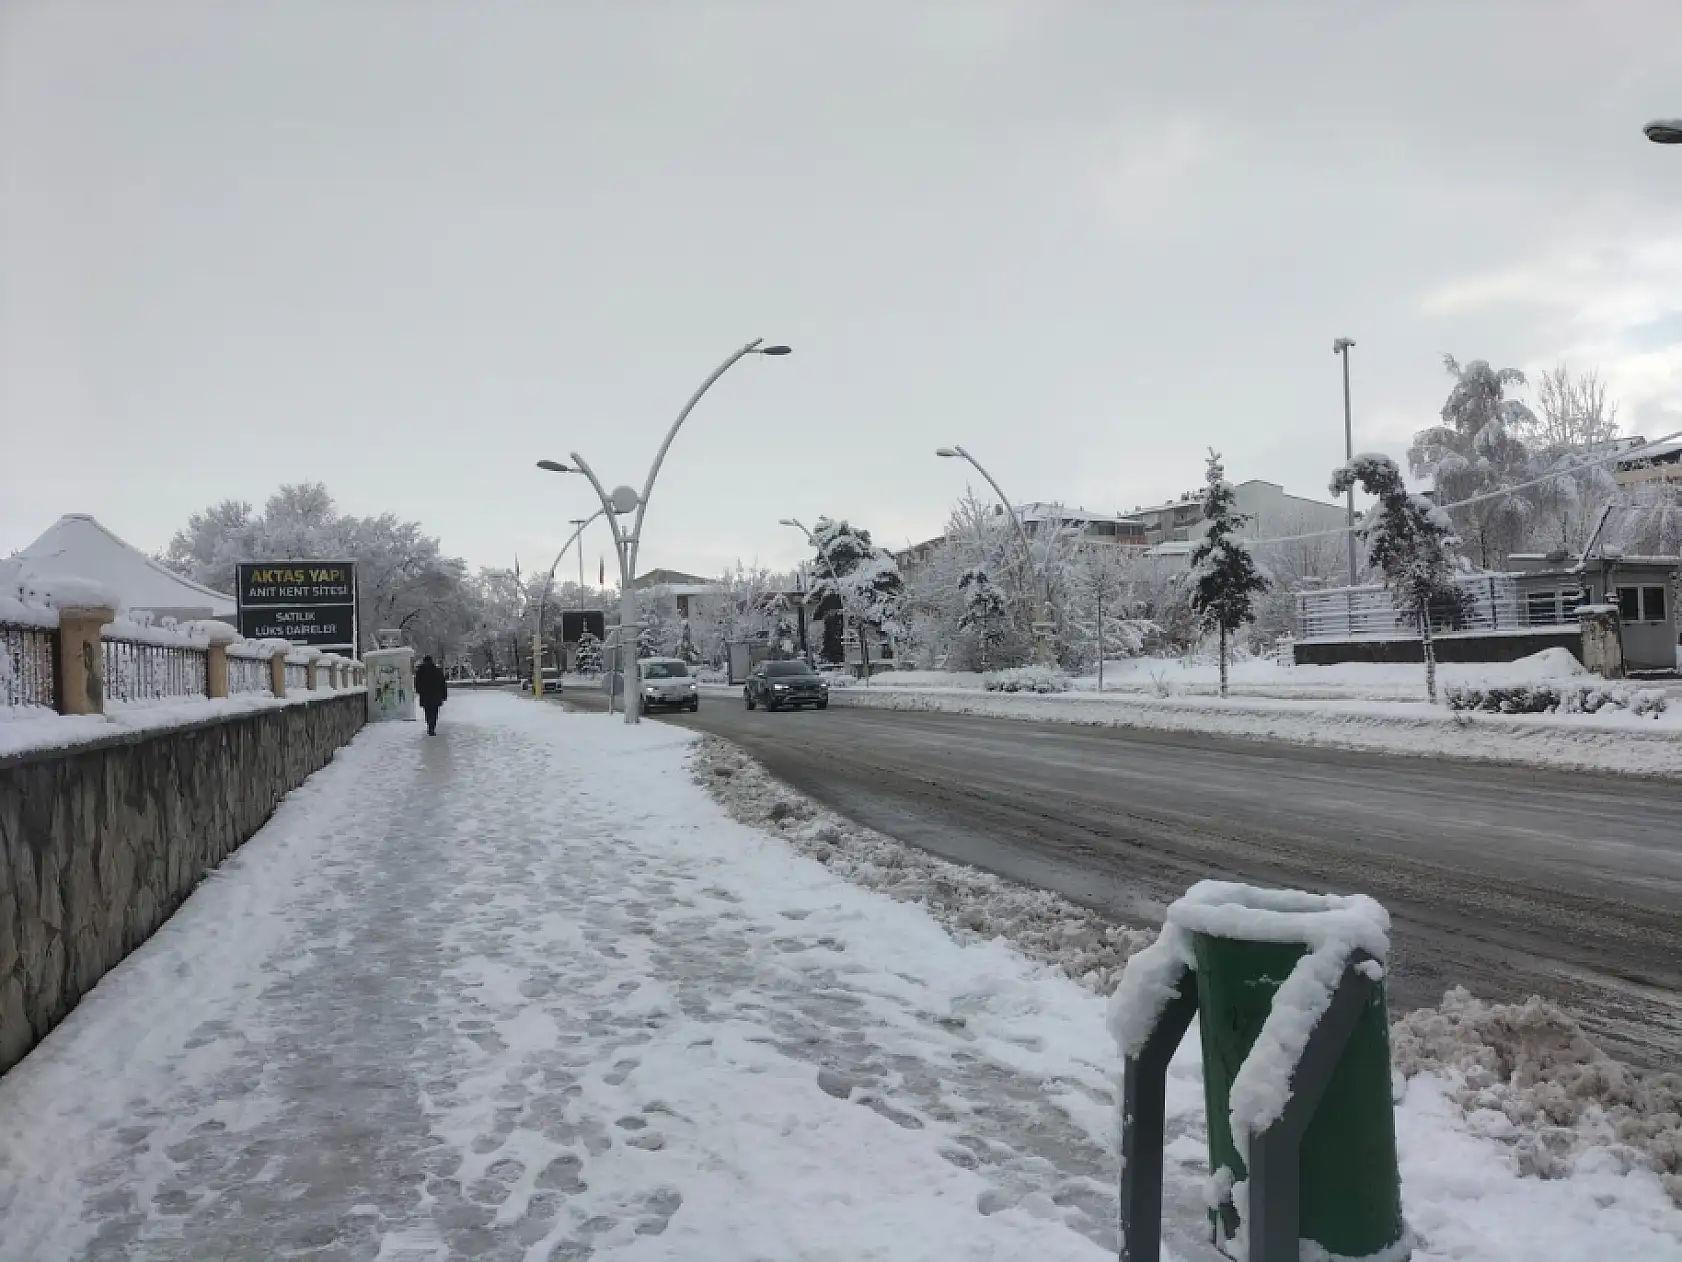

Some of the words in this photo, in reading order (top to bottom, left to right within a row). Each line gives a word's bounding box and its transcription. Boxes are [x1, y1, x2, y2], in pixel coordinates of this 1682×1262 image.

[309, 569, 344, 581] YAPI
[249, 586, 276, 597] ANIT
[279, 586, 309, 597] KENT
[275, 612, 315, 622] SATILIK
[255, 623, 284, 636] LÜKS
